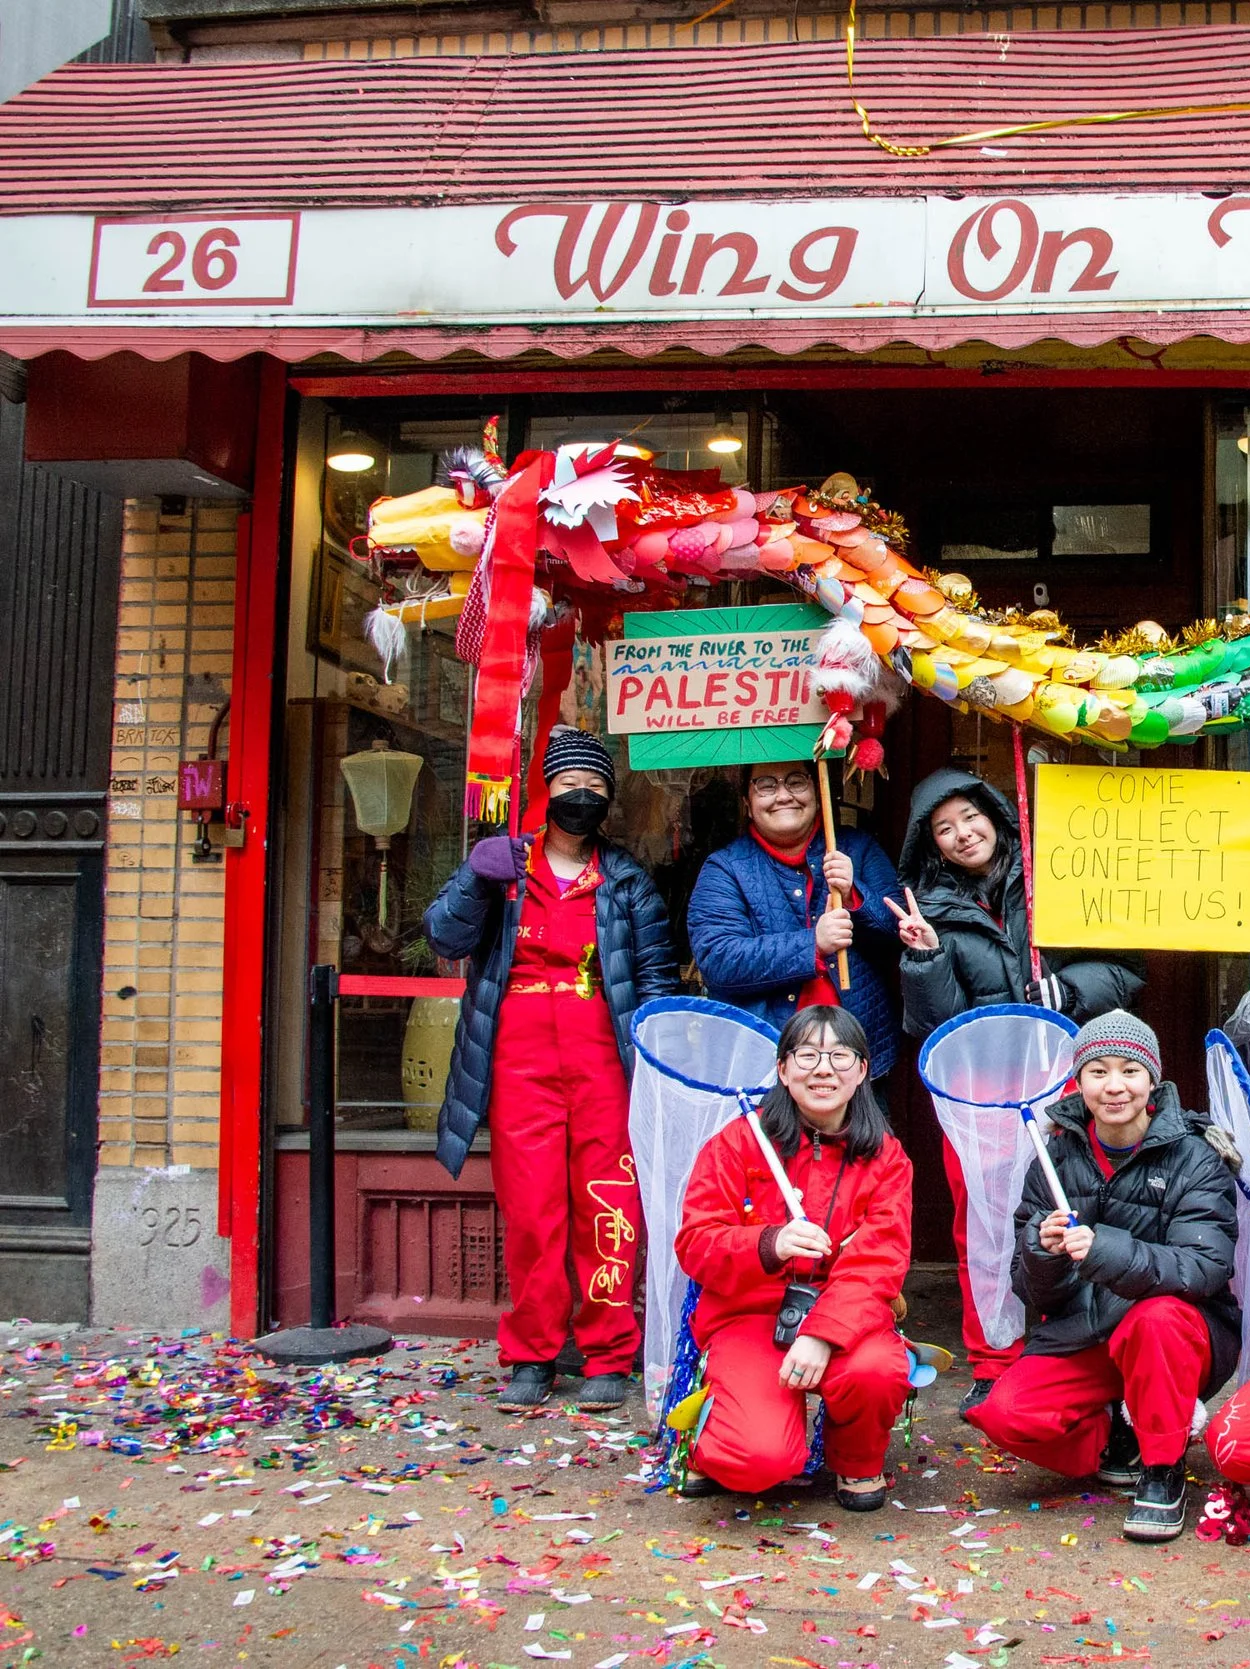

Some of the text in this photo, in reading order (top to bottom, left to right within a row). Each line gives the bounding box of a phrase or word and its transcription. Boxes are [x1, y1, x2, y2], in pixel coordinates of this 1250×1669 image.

[142, 227, 239, 293] 26
[494, 202, 860, 303] Wing
[946, 199, 1120, 302] On
[614, 637, 810, 660] FROM THE RIVER TO THE
[616, 670, 812, 715] PALESTI
[646, 707, 800, 728] WILL BE FREE
[1097, 771, 1185, 805] COME
[1068, 805, 1229, 846] COLLECT
[1050, 845, 1225, 882] CONFETTI
[1081, 887, 1243, 928] WITH US!
[133, 1206, 202, 1248] 925
